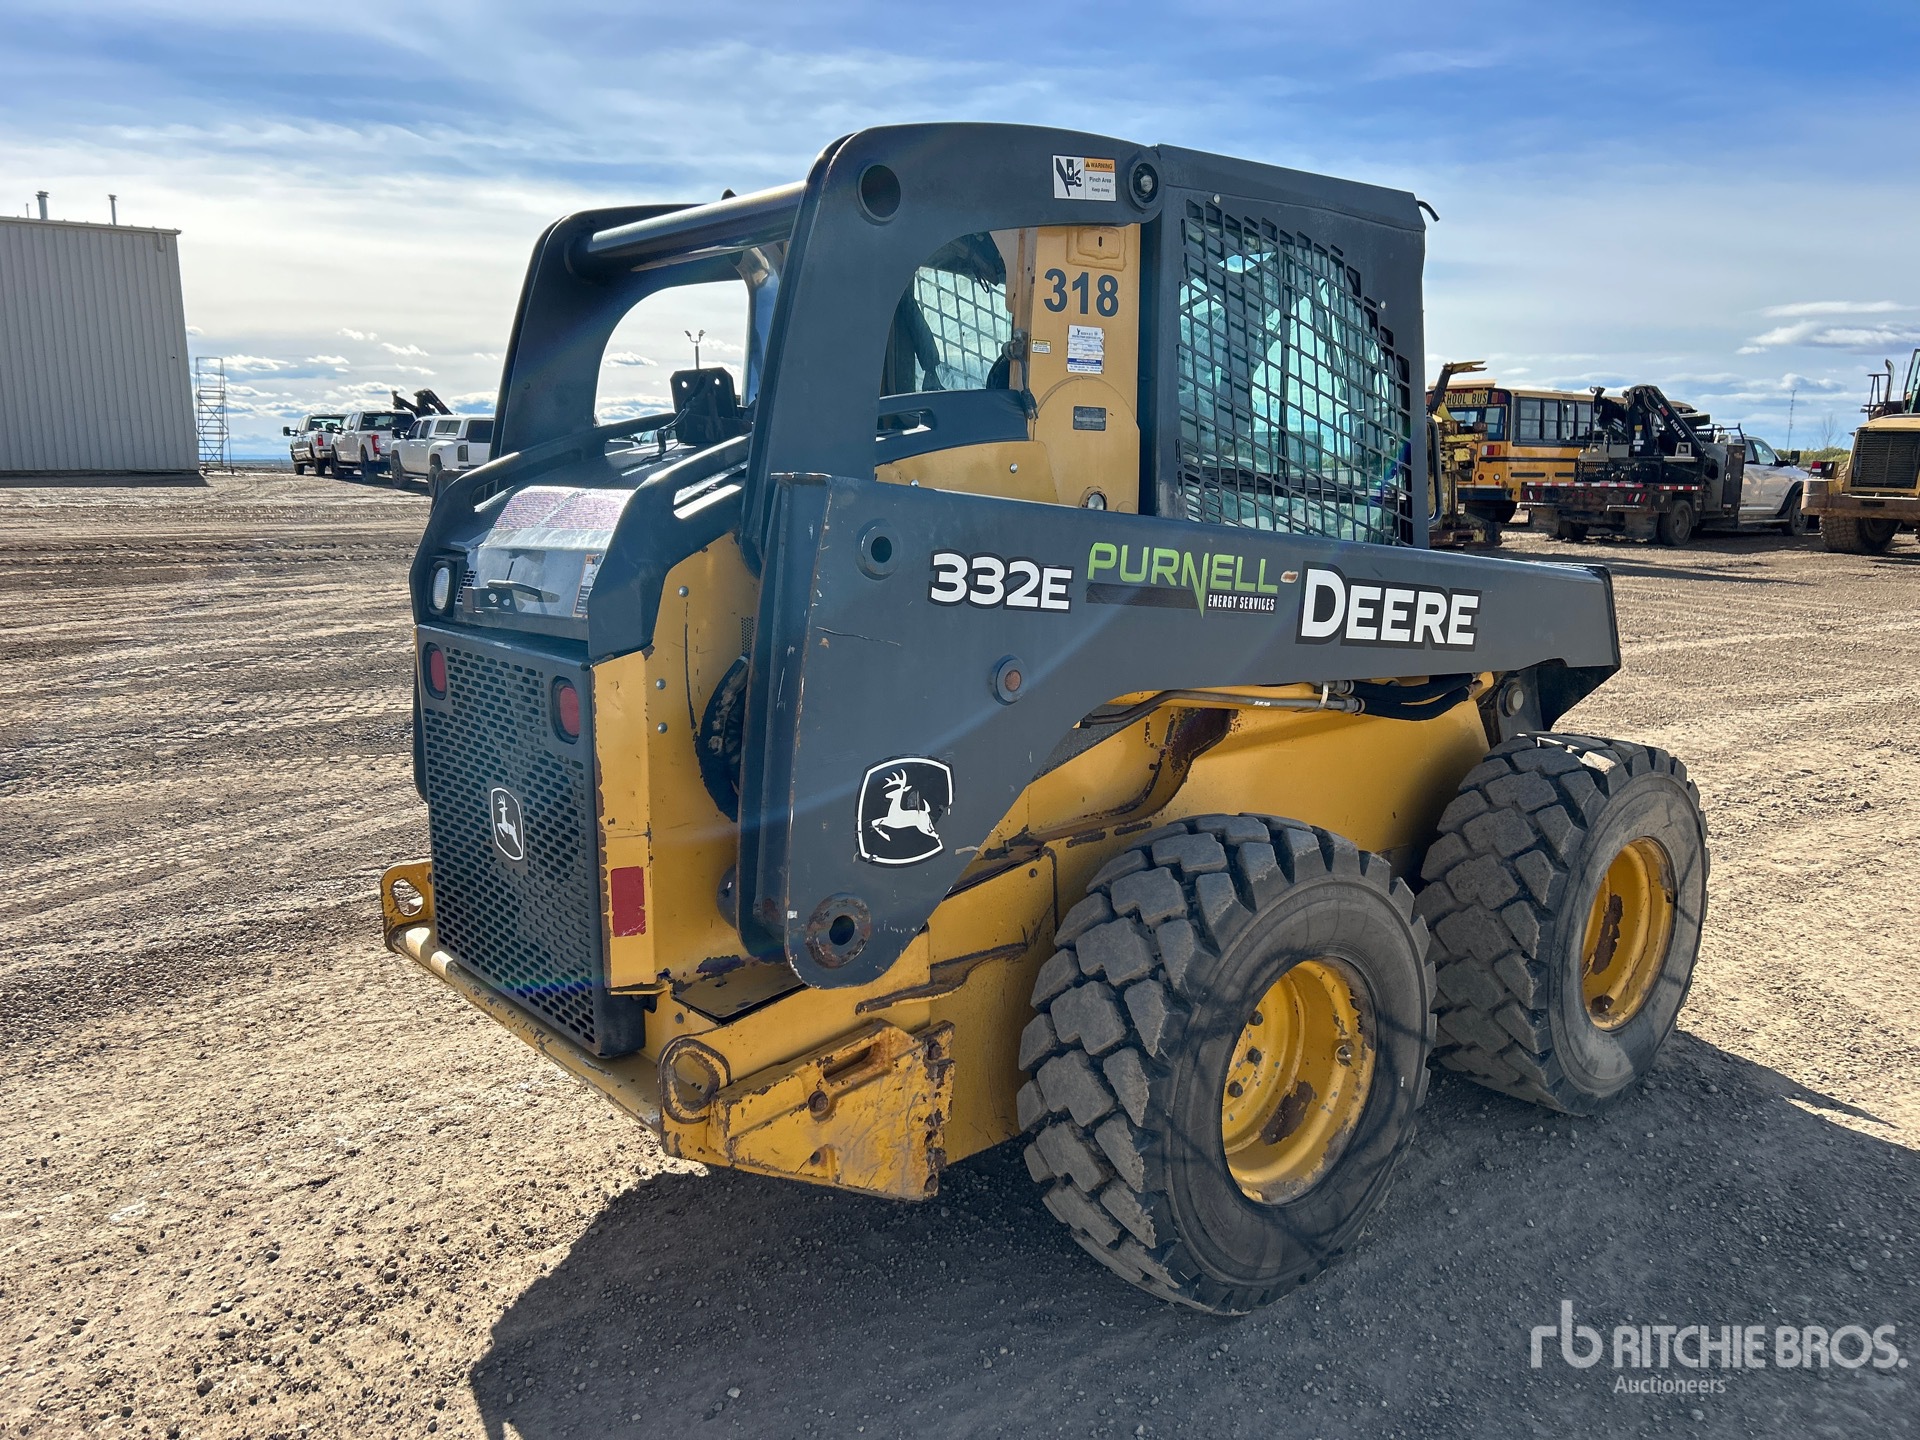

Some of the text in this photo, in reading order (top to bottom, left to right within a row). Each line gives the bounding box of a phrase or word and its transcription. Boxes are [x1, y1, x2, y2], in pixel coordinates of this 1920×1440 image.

[1090, 162, 1113, 170] WARNING
[1043, 268, 1119, 317] 318
[1446, 392, 1488, 405] HOOL BUS
[930, 552, 1073, 611] 332E
[1087, 542, 1279, 618] PURNELL
[1207, 594, 1275, 611] ENERGY SERVICES
[1300, 568, 1480, 646] DEERE
